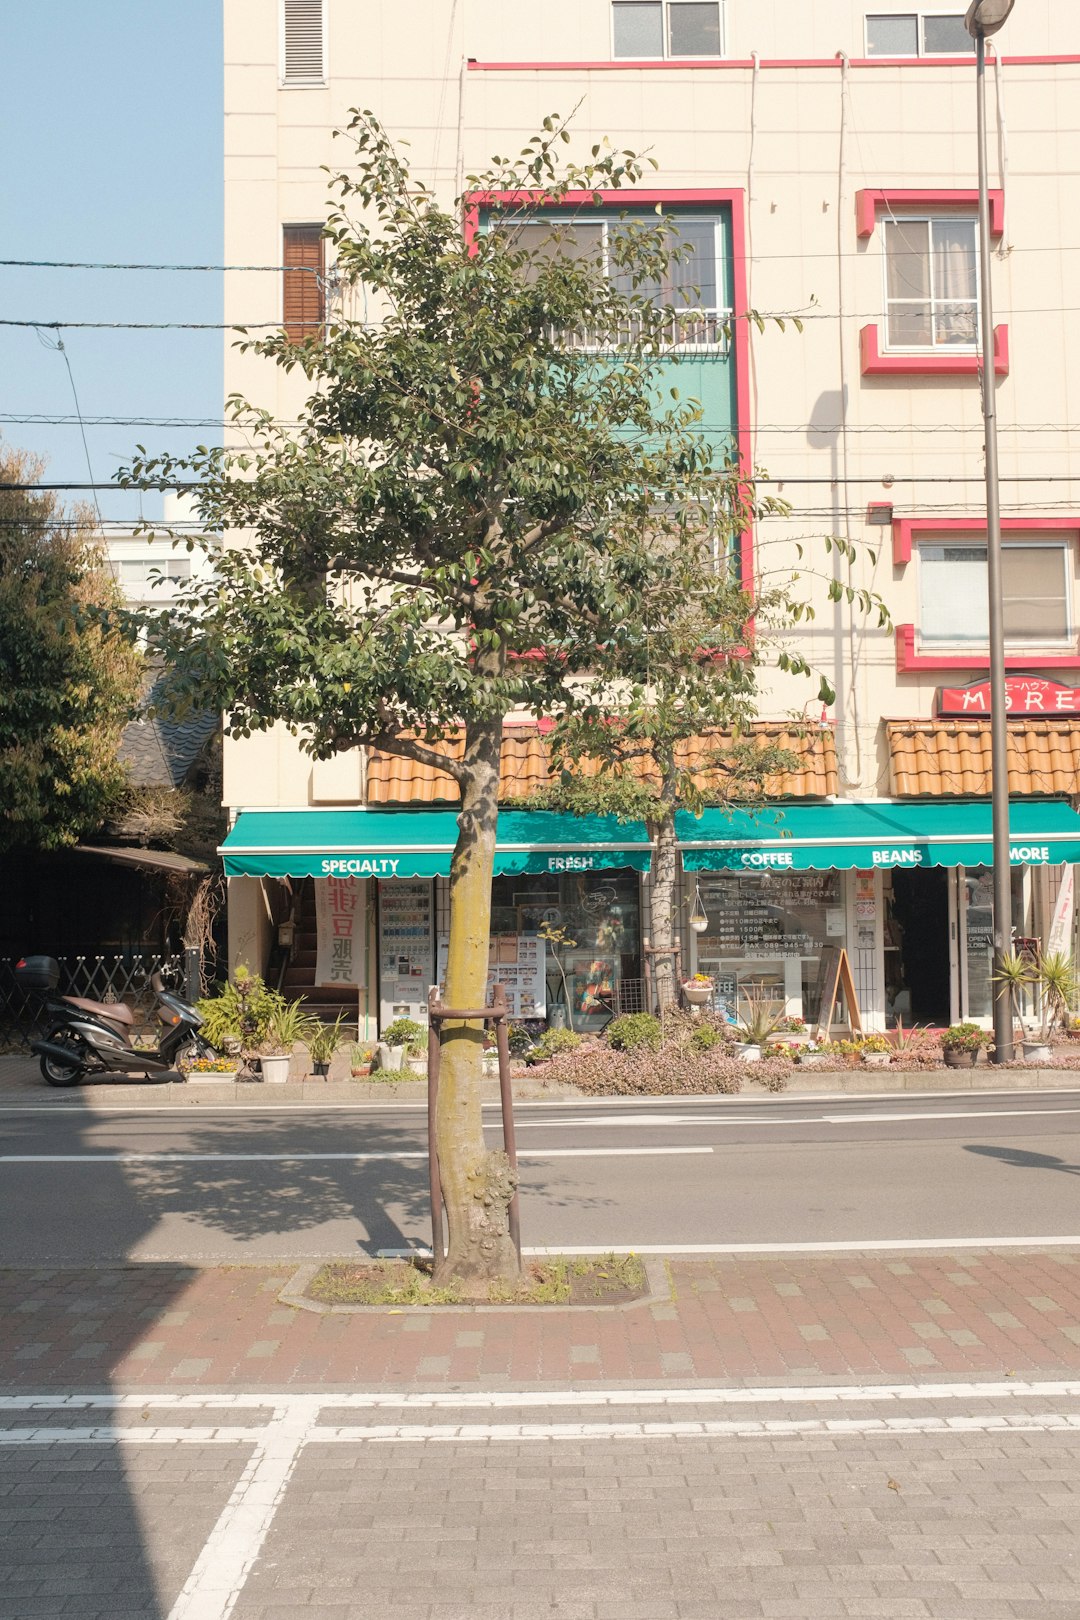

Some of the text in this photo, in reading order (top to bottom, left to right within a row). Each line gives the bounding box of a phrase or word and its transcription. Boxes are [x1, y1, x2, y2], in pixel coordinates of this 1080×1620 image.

[988, 681, 1050, 692] ヒーハウス
[741, 852, 793, 865] COFFEE
[872, 849, 923, 864] BEANS
[1009, 847, 1050, 861] MORE
[321, 859, 400, 873] SPECIALTY
[548, 856, 594, 870] FRESH
